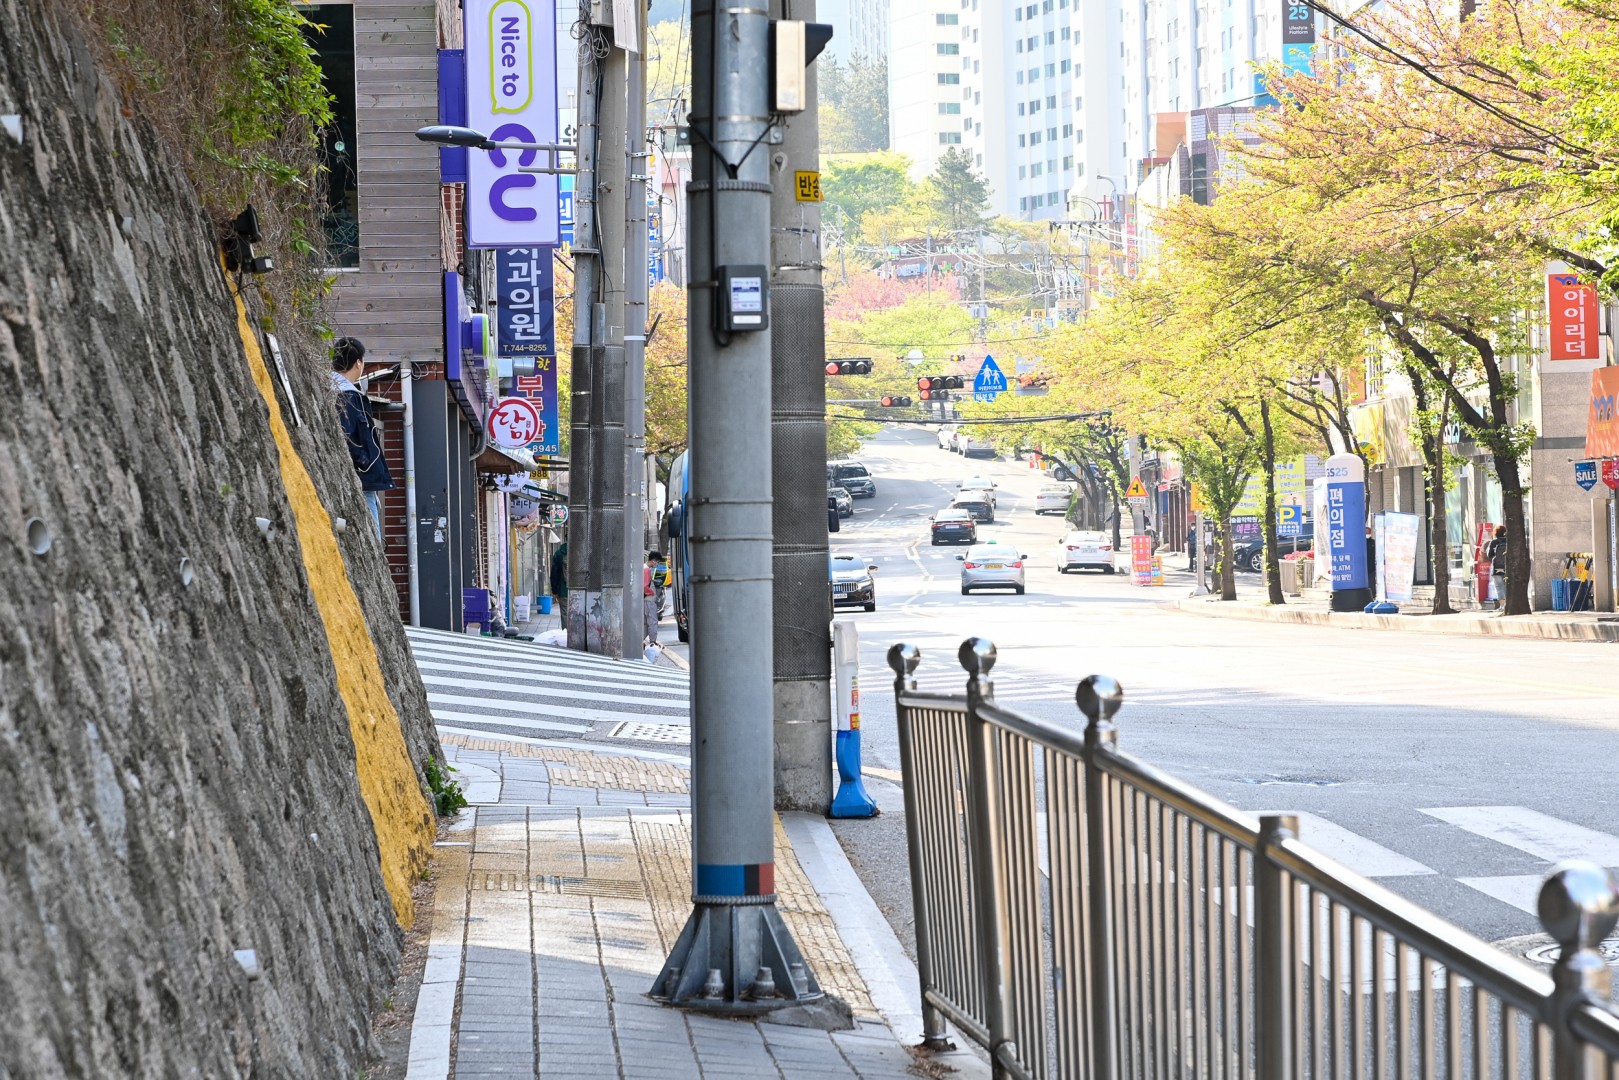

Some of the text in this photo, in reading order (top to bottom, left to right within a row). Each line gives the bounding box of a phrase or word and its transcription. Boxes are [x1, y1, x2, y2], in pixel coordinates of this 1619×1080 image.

[1288, 6, 1309, 20] 25
[500, 16, 520, 97] Nice to
[489, 123, 537, 222] CU
[503, 344, 547, 352] T.744-8255
[1563, 289, 1587, 357] 아이리더
[1576, 470, 1597, 482] SALE
[1329, 487, 1345, 549] 편의점
